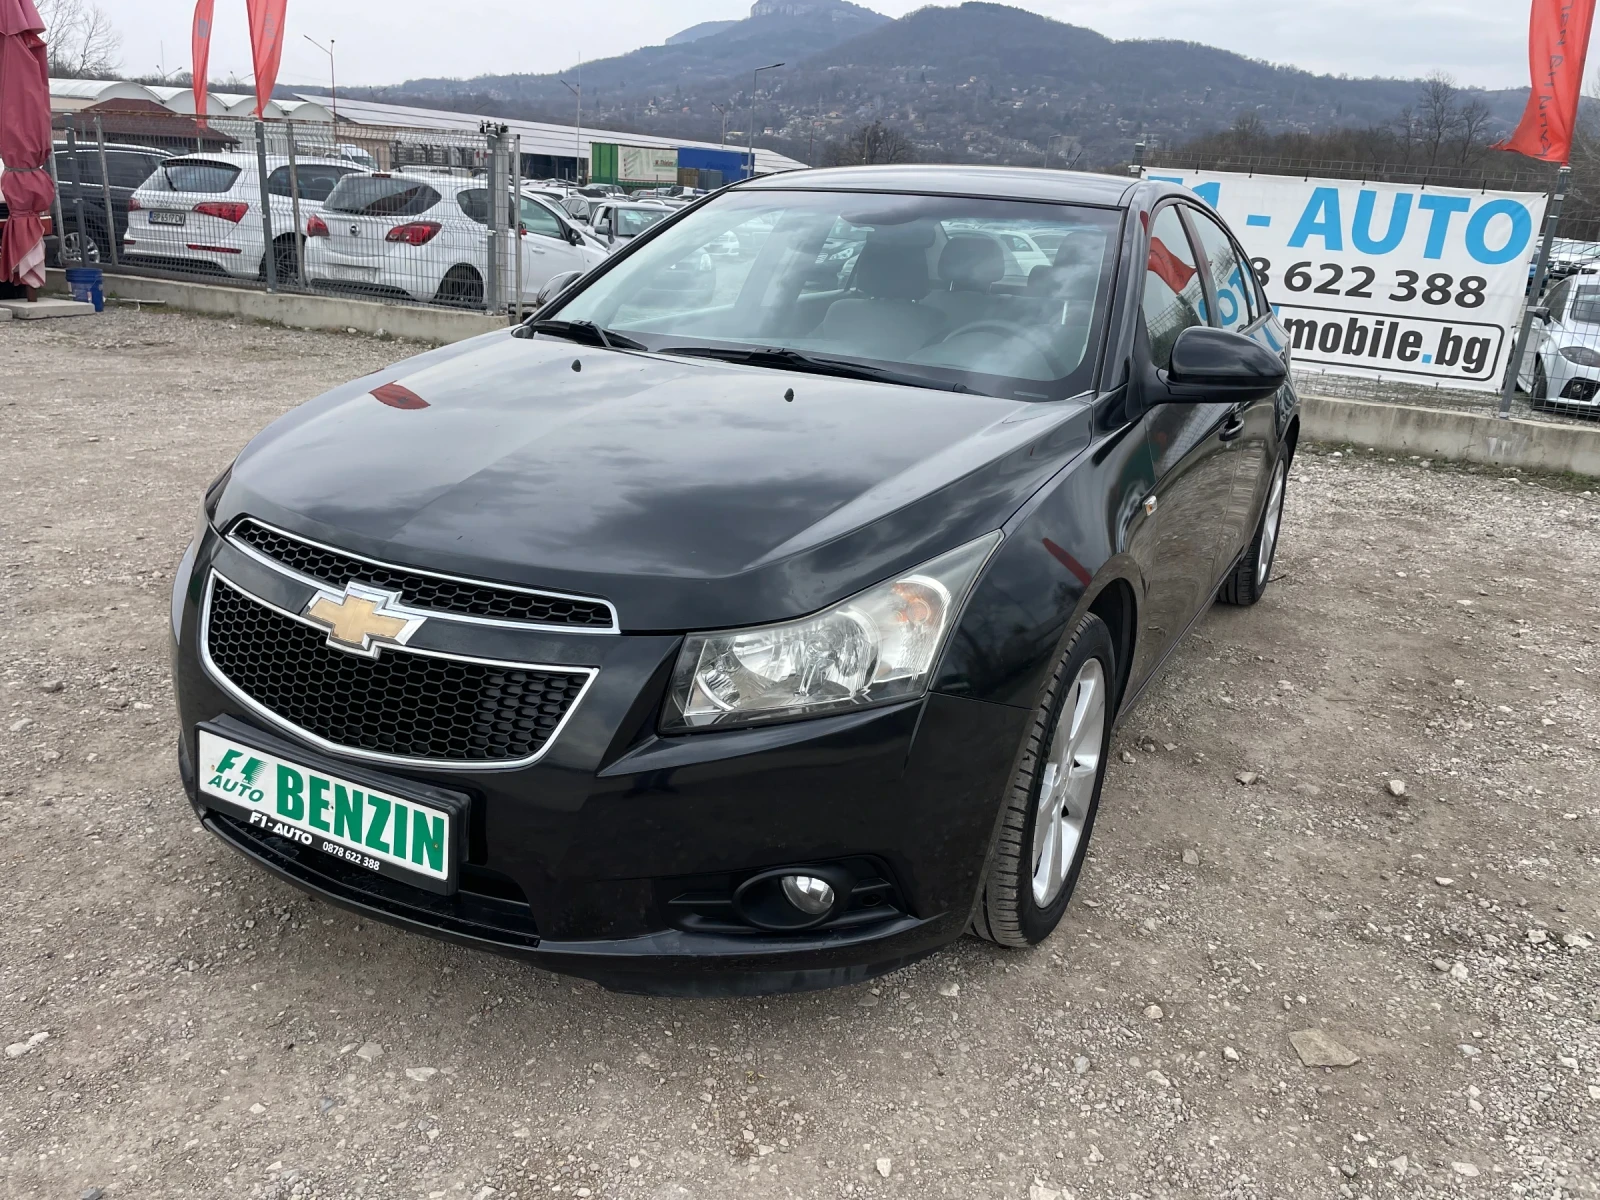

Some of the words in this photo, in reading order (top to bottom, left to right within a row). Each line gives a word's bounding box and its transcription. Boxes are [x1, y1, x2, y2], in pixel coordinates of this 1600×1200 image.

[1287, 187, 1532, 265] AUTO
[1283, 261, 1374, 300] 622
[1389, 269, 1487, 308] 388
[1284, 317, 1491, 374] mobile.bg
[207, 774, 265, 803] AUTO
[249, 811, 313, 845] F1-AUTO
[276, 763, 445, 873] BENZIN
[322, 841, 344, 857] 0878
[345, 850, 362, 864] 622
[362, 856, 380, 871] 388
